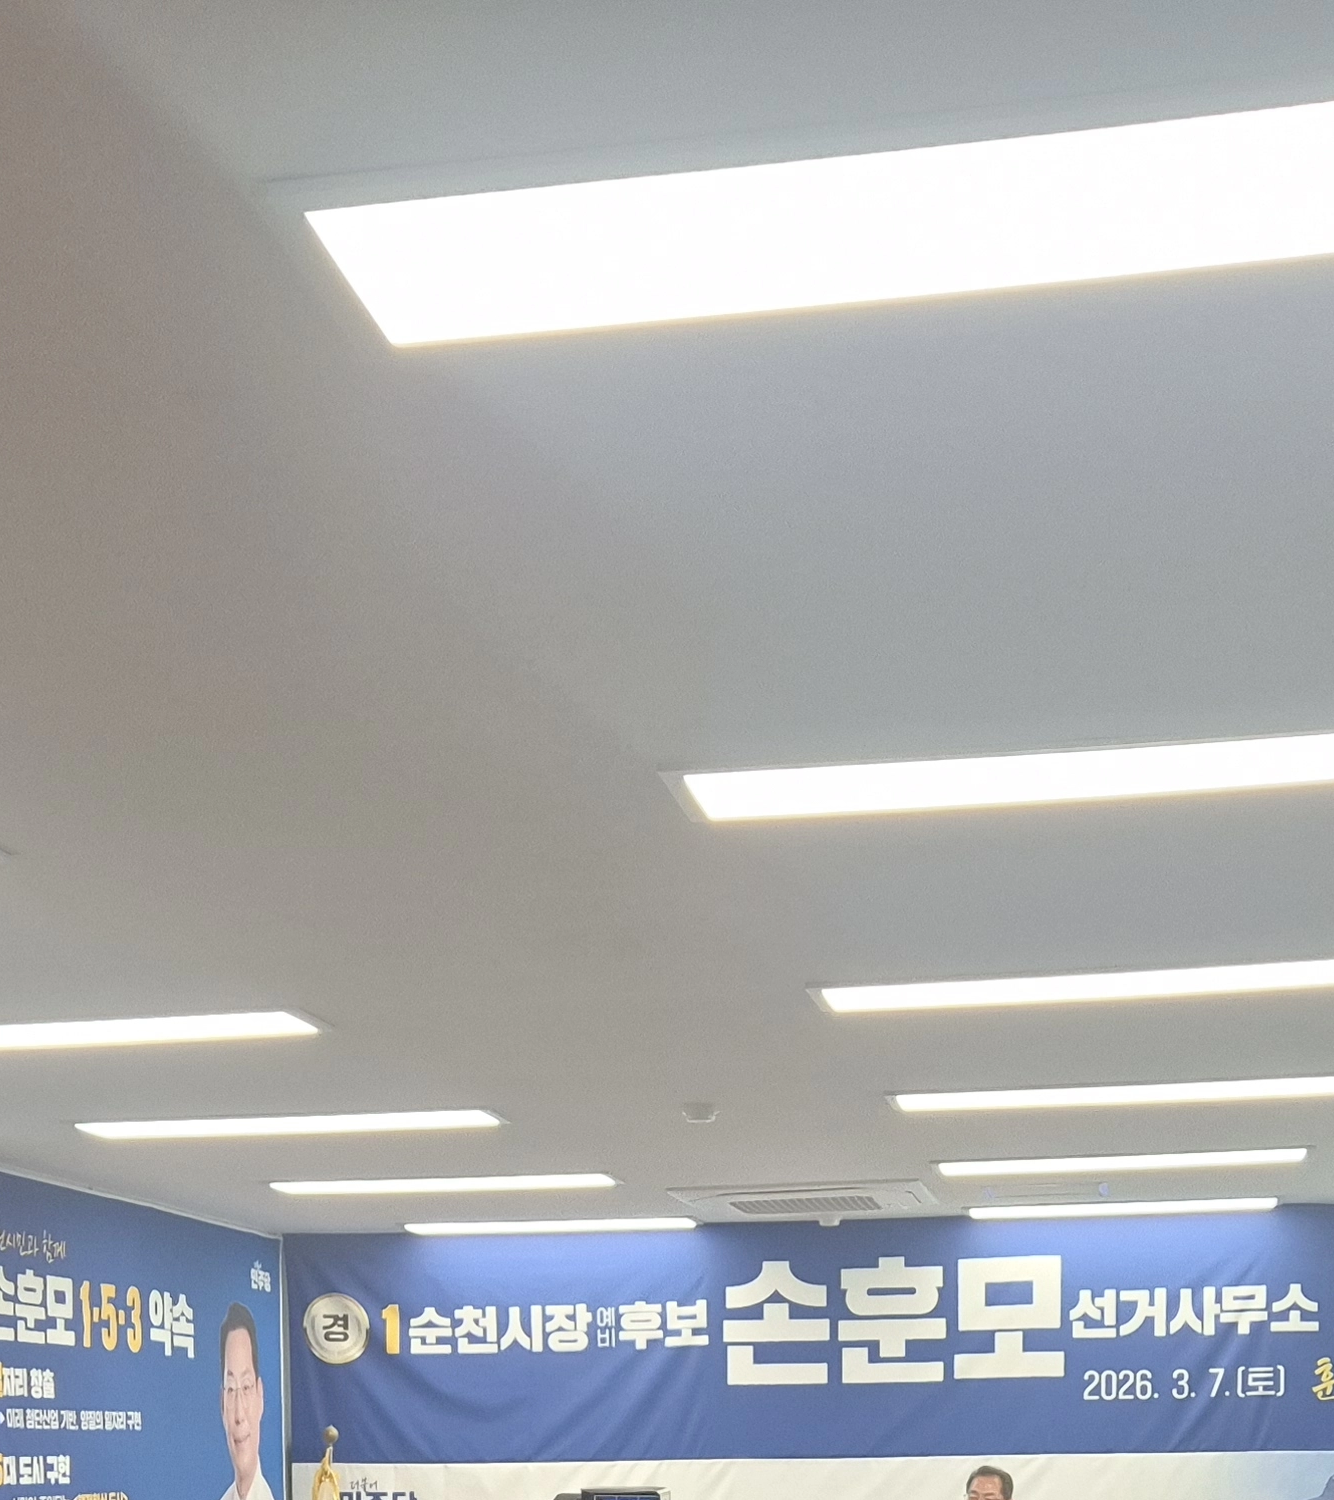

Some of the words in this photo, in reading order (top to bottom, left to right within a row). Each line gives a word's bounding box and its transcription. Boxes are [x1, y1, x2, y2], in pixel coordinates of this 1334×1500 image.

[42, 1229, 66, 1263] 함께
[149, 1288, 195, 1360] 약속
[322, 1313, 350, 1343] 경
[381, 1304, 400, 1354] 1
[409, 1303, 592, 1355] 순천시장
[618, 1299, 709, 1350] 후보
[722, 1255, 1066, 1385] 손훈모
[1069, 1283, 1320, 1339] 선거사무소
[30, 1368, 55, 1399] 창출
[1083, 1368, 1160, 1401] 2026.
[1172, 1367, 1196, 1400] 3.
[6, 1408, 24, 1429] 미래
[26, 1408, 59, 1430] 첨단산업
[80, 1410, 103, 1431] 양질의
[105, 1410, 126, 1431] 일자리
[127, 1411, 142, 1431] 구현
[19, 1455, 44, 1485] 도시
[46, 1454, 70, 1485] 구현
